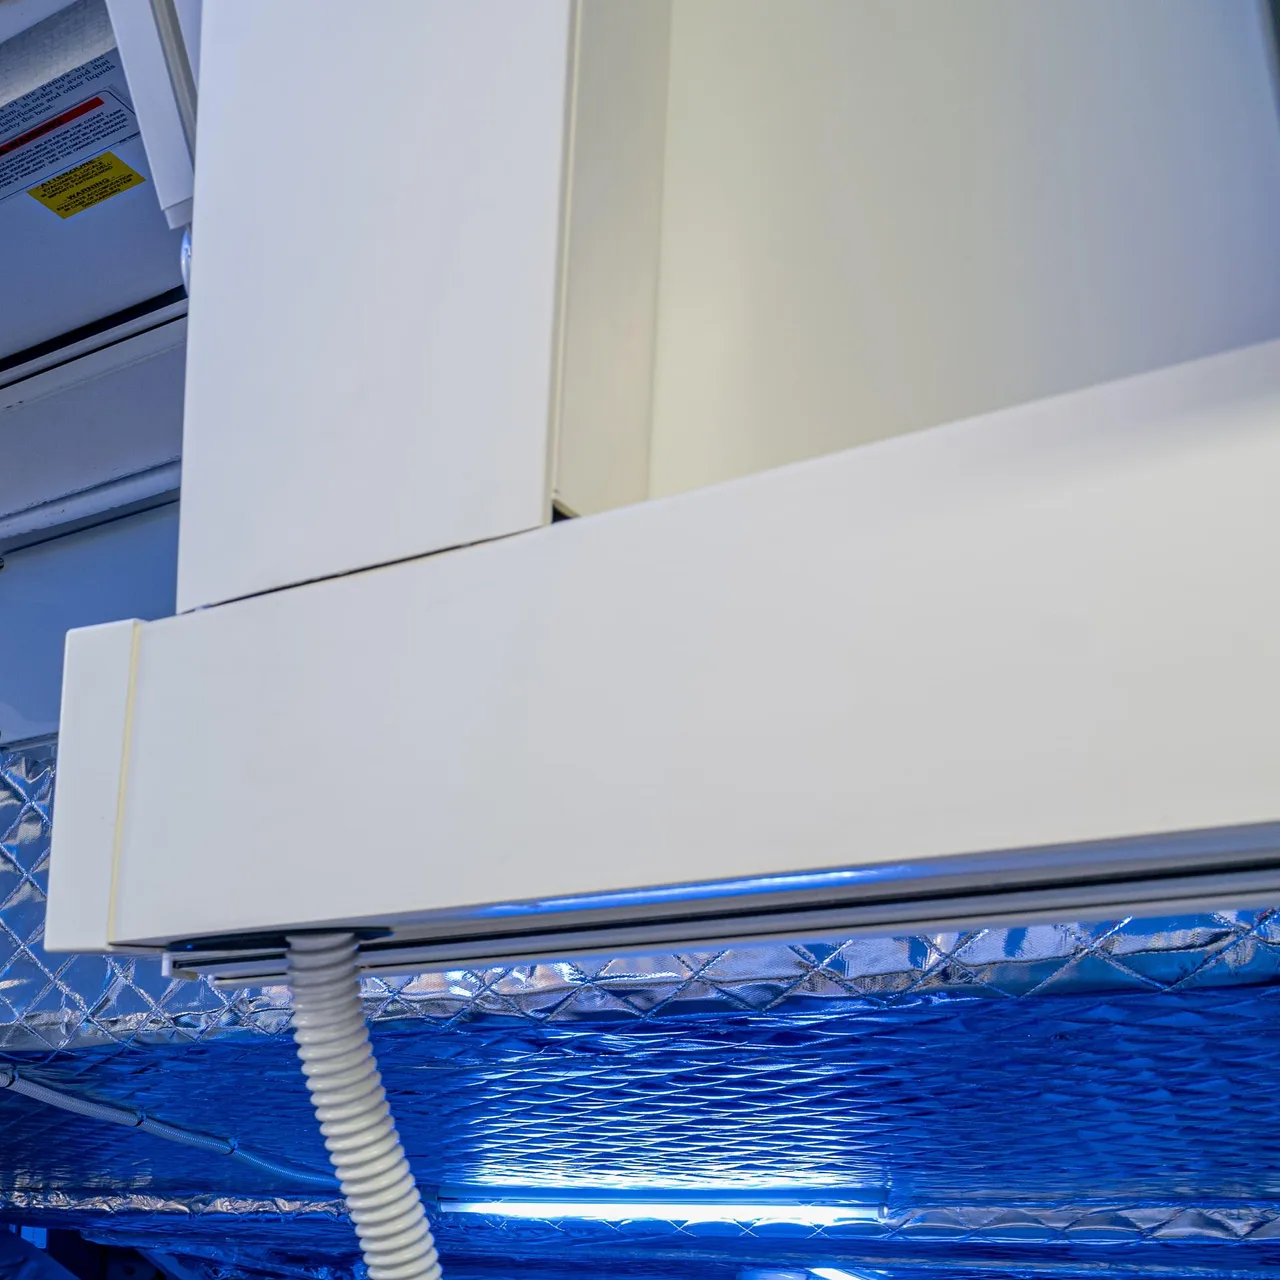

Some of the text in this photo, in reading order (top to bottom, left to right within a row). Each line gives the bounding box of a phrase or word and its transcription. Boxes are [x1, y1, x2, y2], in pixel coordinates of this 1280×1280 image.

[30, 89, 54, 103] order
[65, 68, 92, 85] avoid
[91, 58, 111, 71] that
[43, 92, 62, 103] and
[60, 79, 86, 94] other
[83, 62, 117, 82] liquids
[3, 147, 35, 164] NAUTICAL
[32, 138, 53, 149] MILES
[50, 129, 71, 140] FROM
[69, 122, 84, 131] THE
[82, 111, 106, 124] COAST
[13, 145, 51, 165] DISCHARGE
[48, 139, 62, 147] THE
[60, 129, 83, 141] BLACK
[81, 117, 106, 130] WATER
[105, 108, 124, 119] TANK
[19, 113, 35, 123] the
[8, 163, 27, 173] KEEP
[24, 148, 57, 165] SWITCHED
[55, 141, 70, 150] OFF
[67, 135, 82, 143] THE
[80, 124, 104, 137] BLACK
[101, 112, 127, 126] WATER
[13, 165, 32, 176] PUMP
[30, 159, 46, 167] AND
[44, 152, 58, 160] THE
[55, 135, 93, 154] AUTOMATIC
[90, 117, 129, 137] DISCHARGE
[59, 150, 74, 158] THE
[65, 177, 111, 200] WARNING
